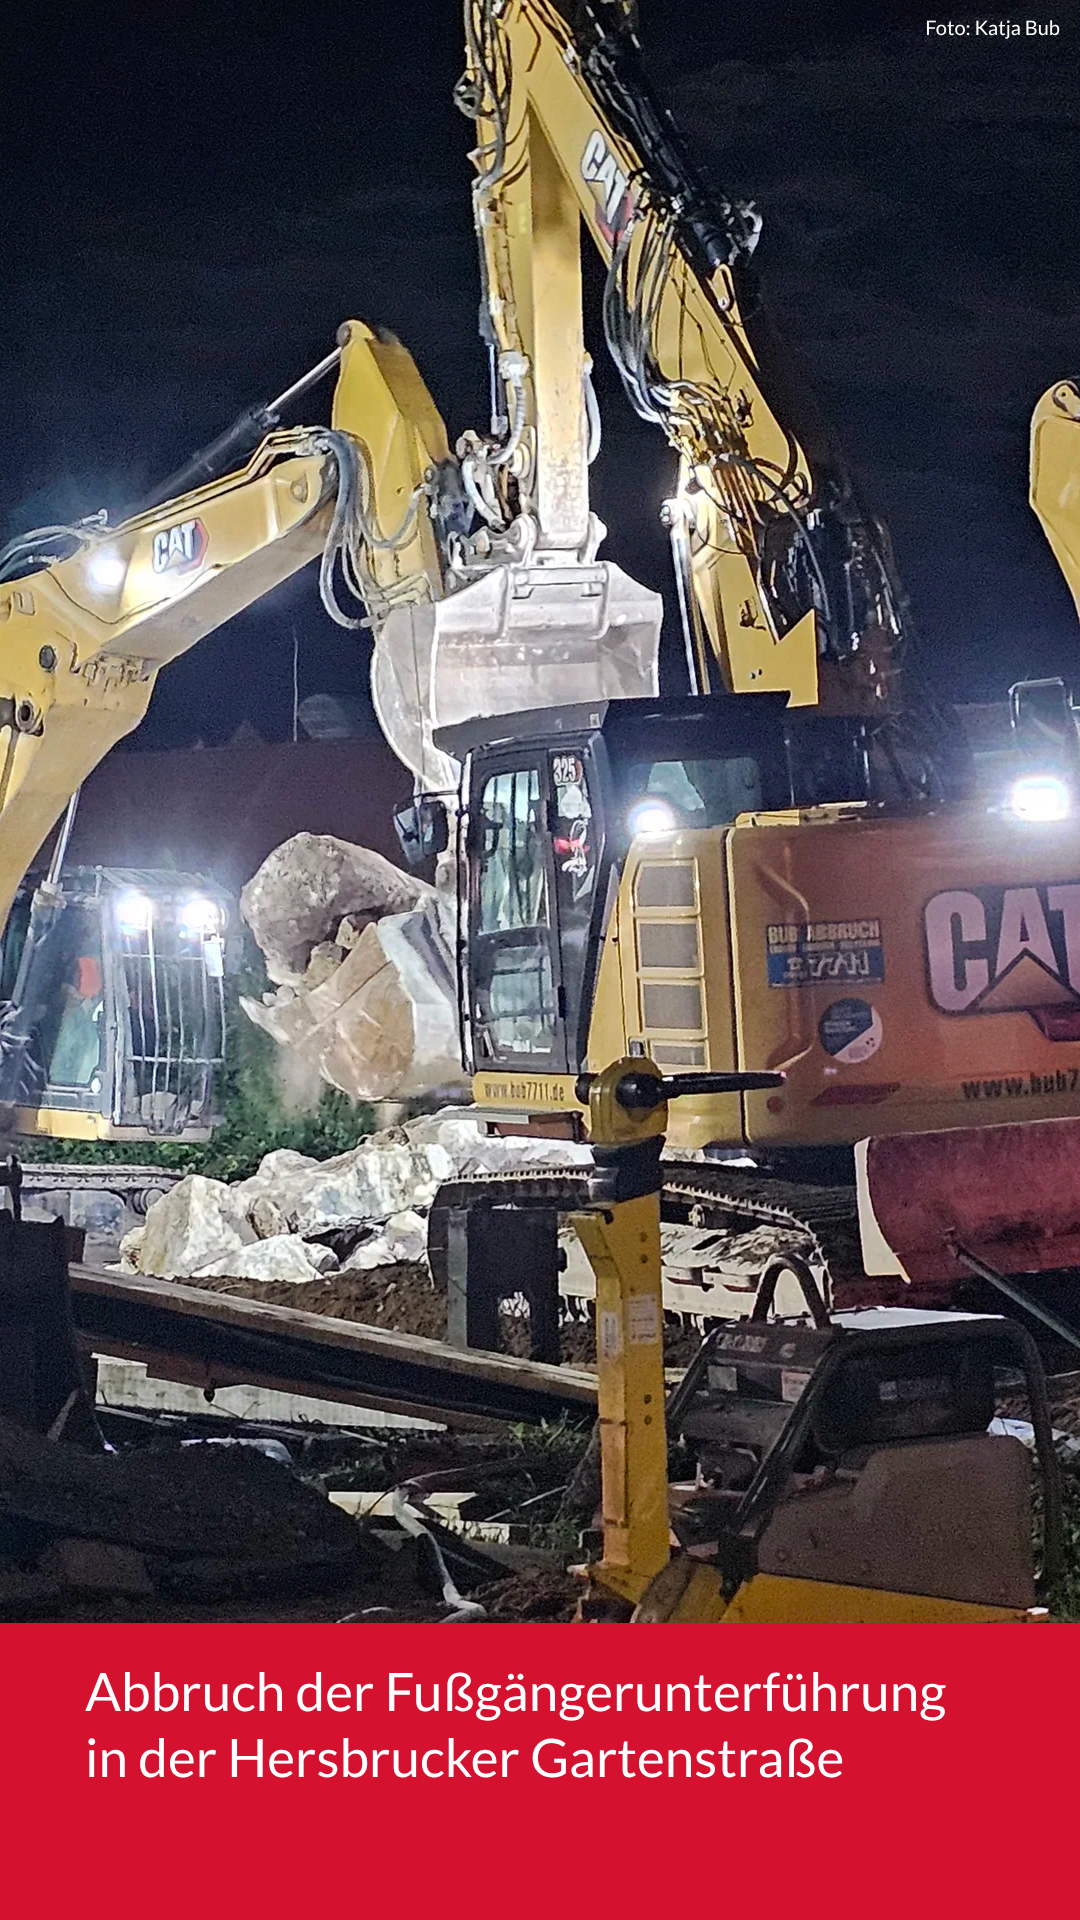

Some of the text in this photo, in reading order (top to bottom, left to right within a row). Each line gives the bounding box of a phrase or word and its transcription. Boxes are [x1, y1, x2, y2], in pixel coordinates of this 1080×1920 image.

[581, 130, 627, 225] CAT
[153, 519, 196, 574] CAT
[552, 756, 577, 783] 325
